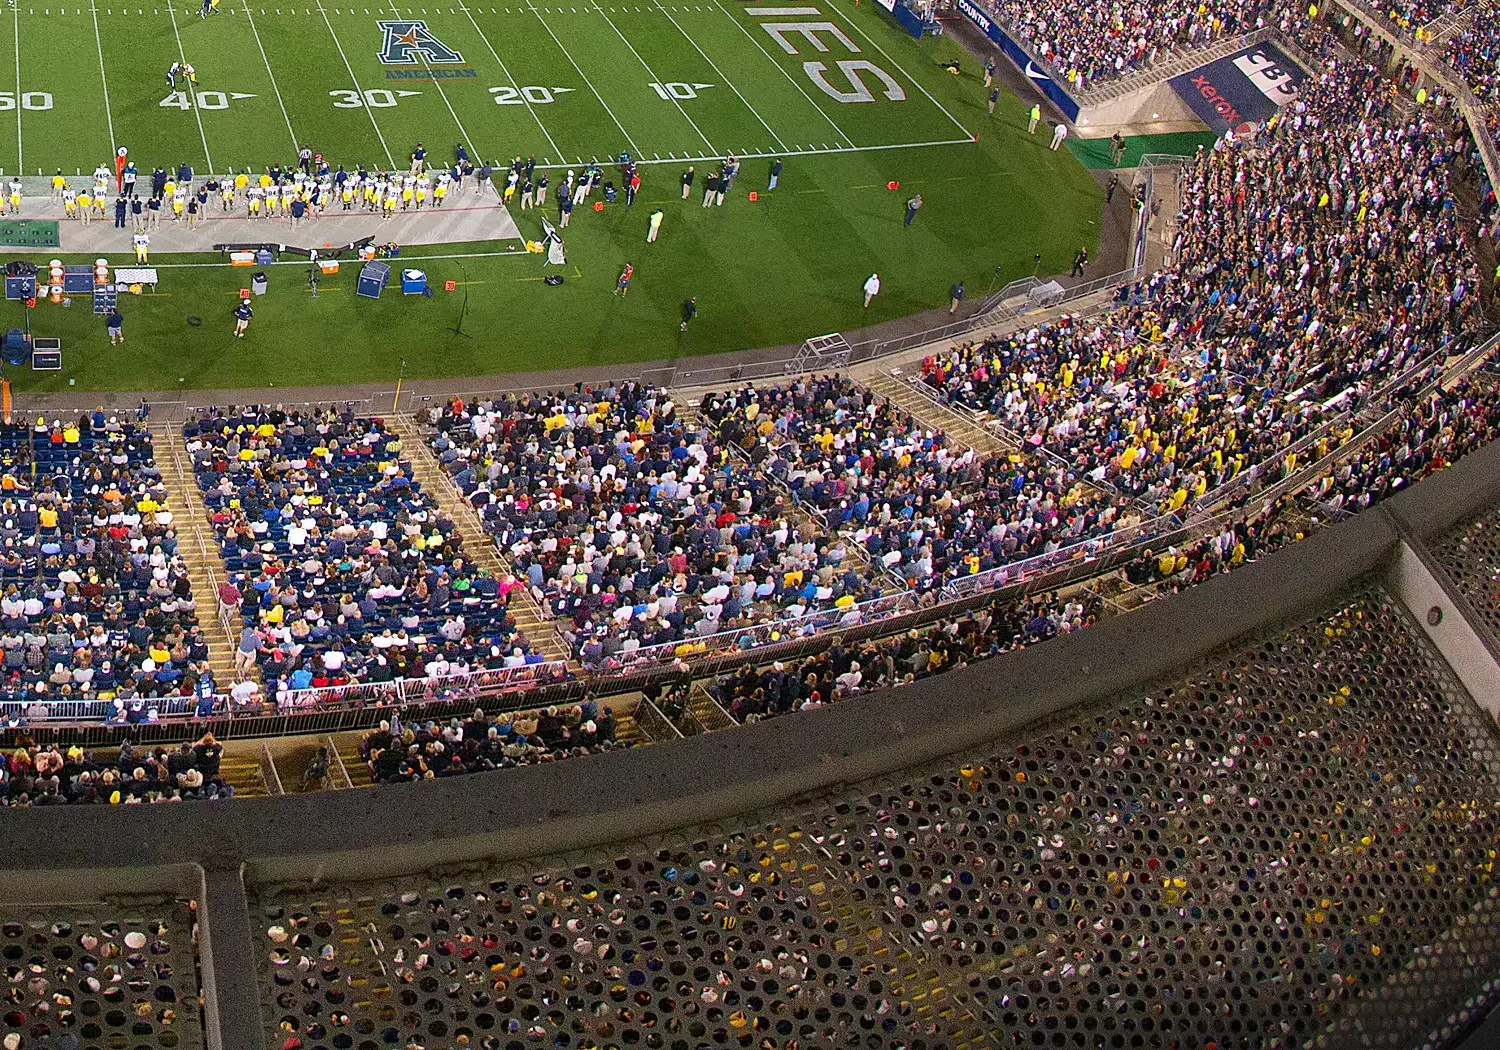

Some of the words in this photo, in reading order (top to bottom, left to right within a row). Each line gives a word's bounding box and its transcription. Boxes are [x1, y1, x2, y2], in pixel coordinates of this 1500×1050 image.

[385, 68, 476, 80] AMERICAN
[1244, 48, 1298, 97] CBS
[329, 90, 397, 108] 30
[489, 87, 554, 105] 20
[648, 83, 698, 99] 10
[1190, 74, 1242, 123] xerox
[159, 91, 229, 110] 40
[436, 667, 442, 676] 6
